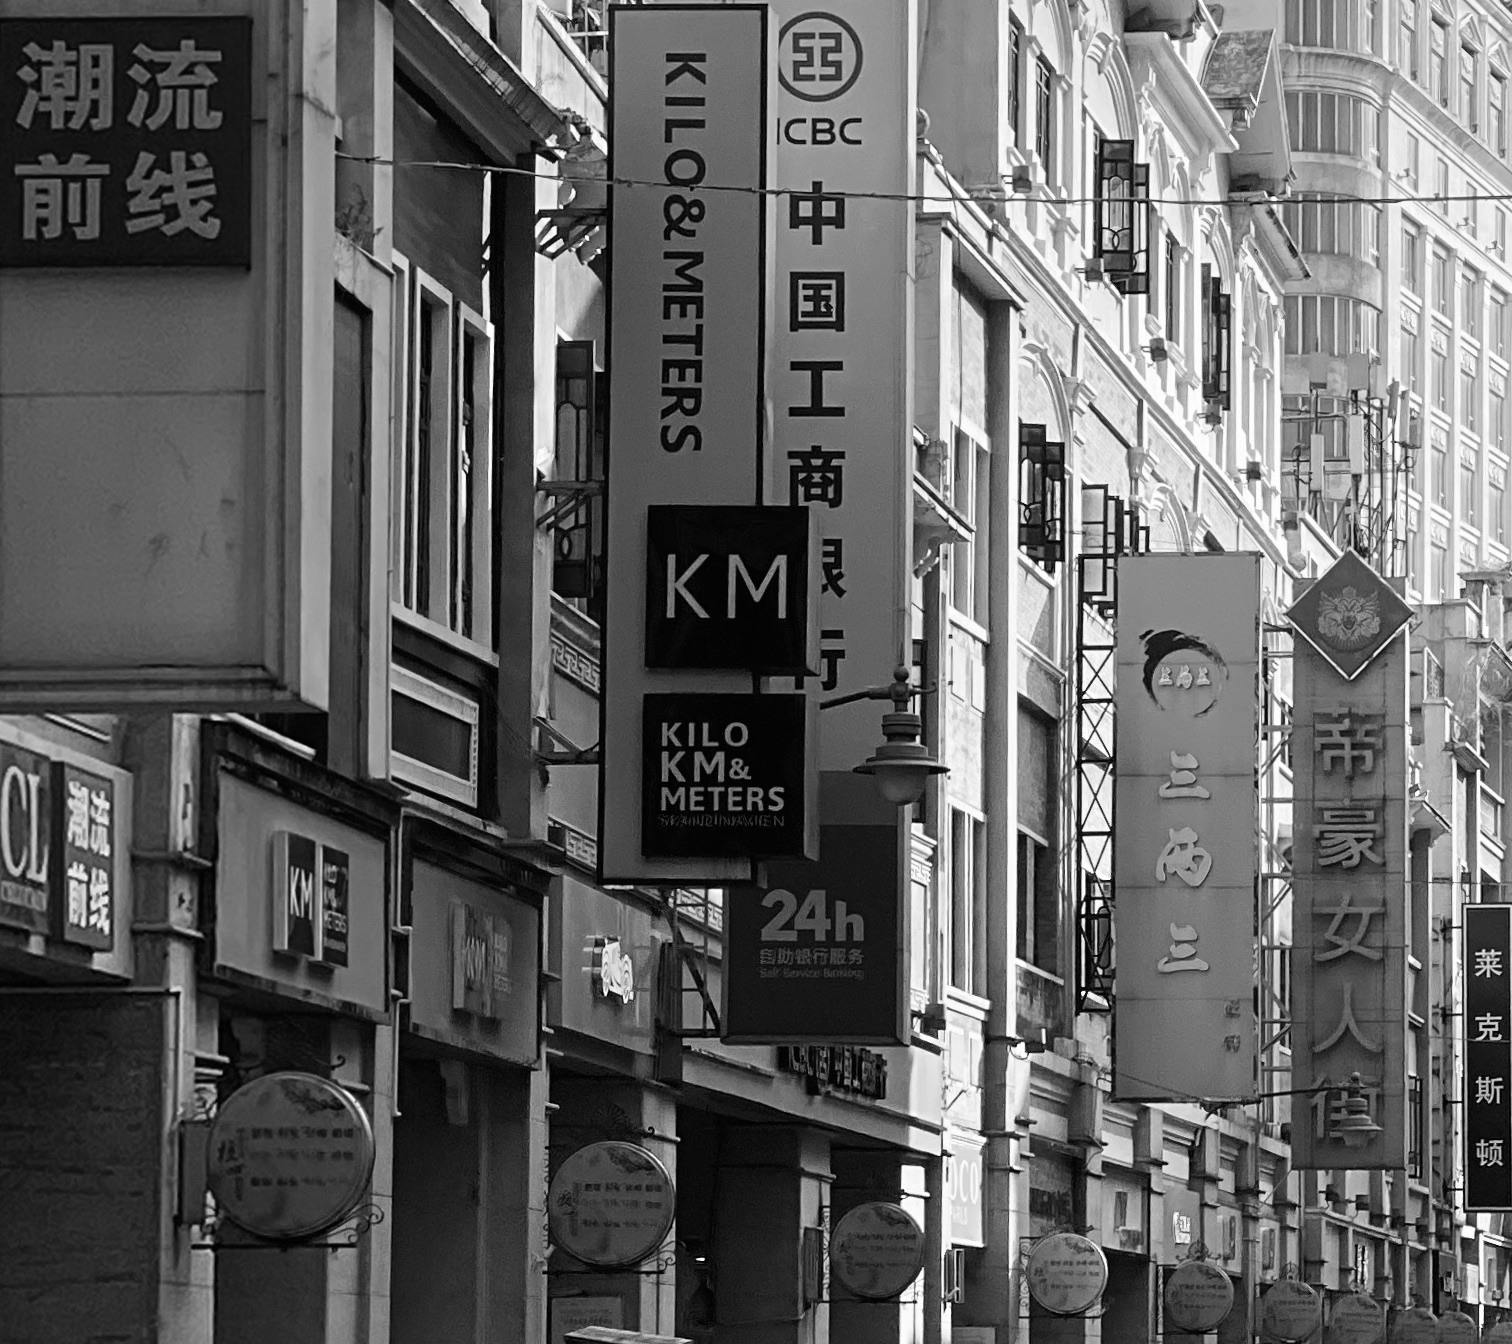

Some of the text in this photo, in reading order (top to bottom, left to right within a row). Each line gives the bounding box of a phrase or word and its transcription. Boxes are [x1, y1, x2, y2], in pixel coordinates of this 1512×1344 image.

[15, 40, 223, 131] 潮流
[14, 151, 221, 239] 前线
[660, 52, 707, 455] KILO&METERS
[665, 552, 788, 620] KM
[660, 721, 749, 748] KILO
[660, 750, 752, 783] KM&
[1, 765, 48, 883] CL
[660, 786, 786, 812] METERS
[290, 865, 314, 921] KM
[760, 888, 865, 942] 24h
[1474, 948, 1505, 1168] 莱克斯顿
